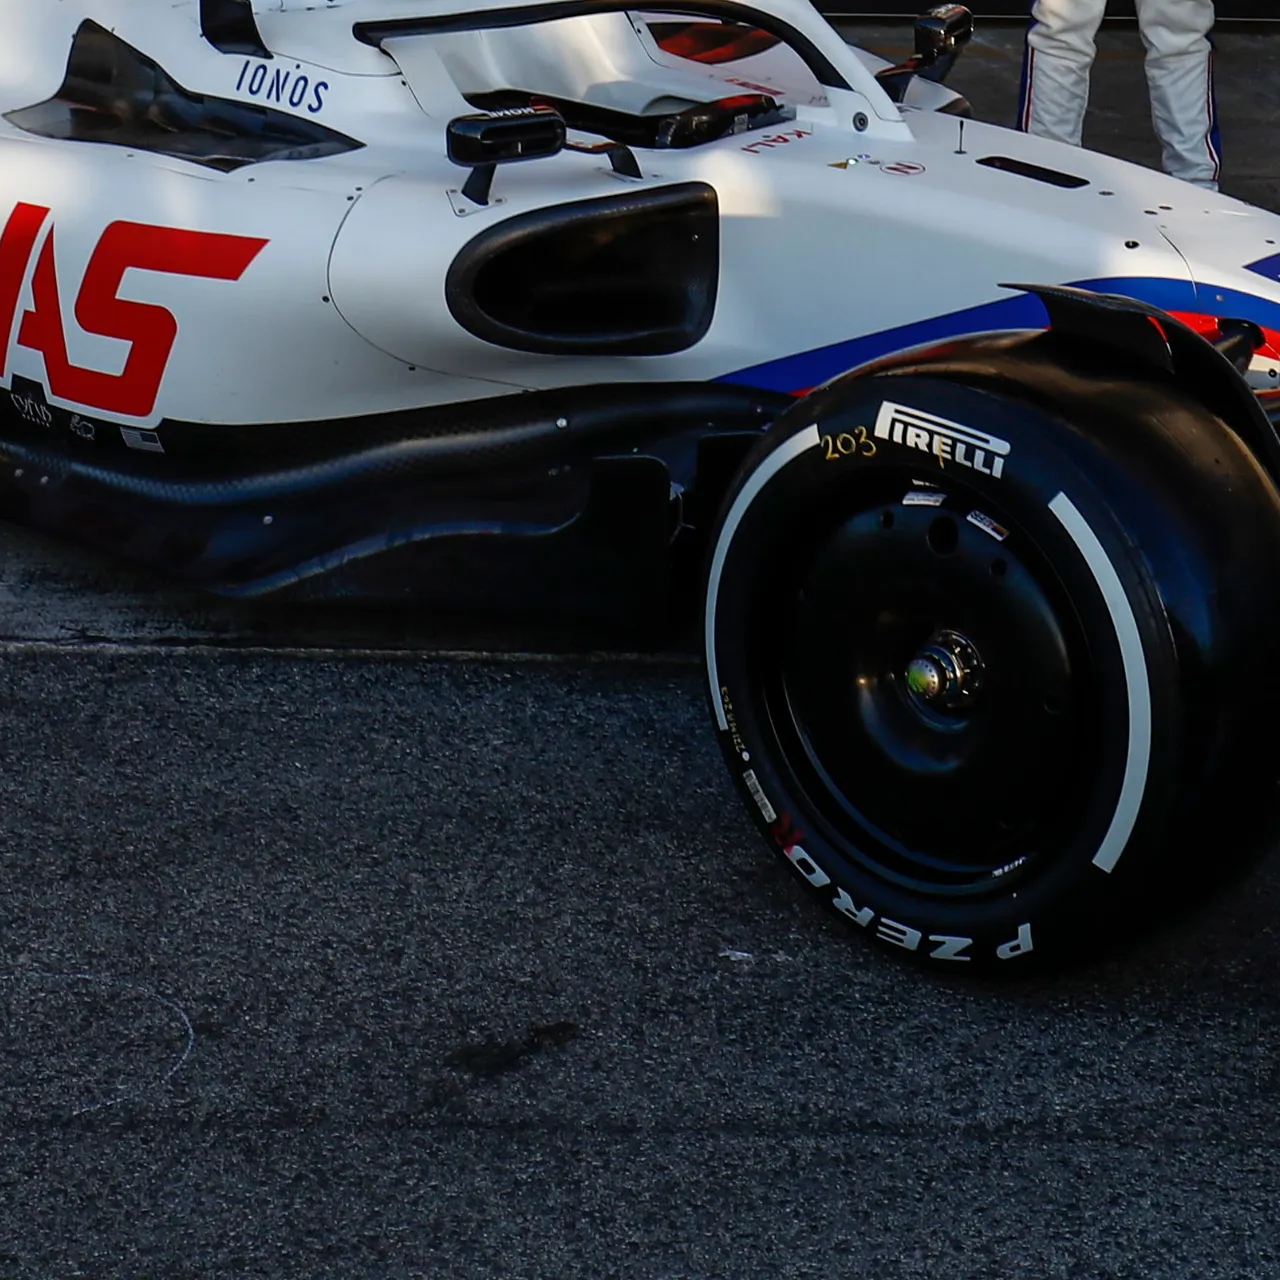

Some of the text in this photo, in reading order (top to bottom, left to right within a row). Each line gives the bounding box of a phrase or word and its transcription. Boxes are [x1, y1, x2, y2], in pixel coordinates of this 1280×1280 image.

[236, 59, 331, 114] IONOS
[820, 425, 877, 461] 203
[874, 400, 1011, 480] PIRELLI
[783, 844, 1034, 962] P ZERO
